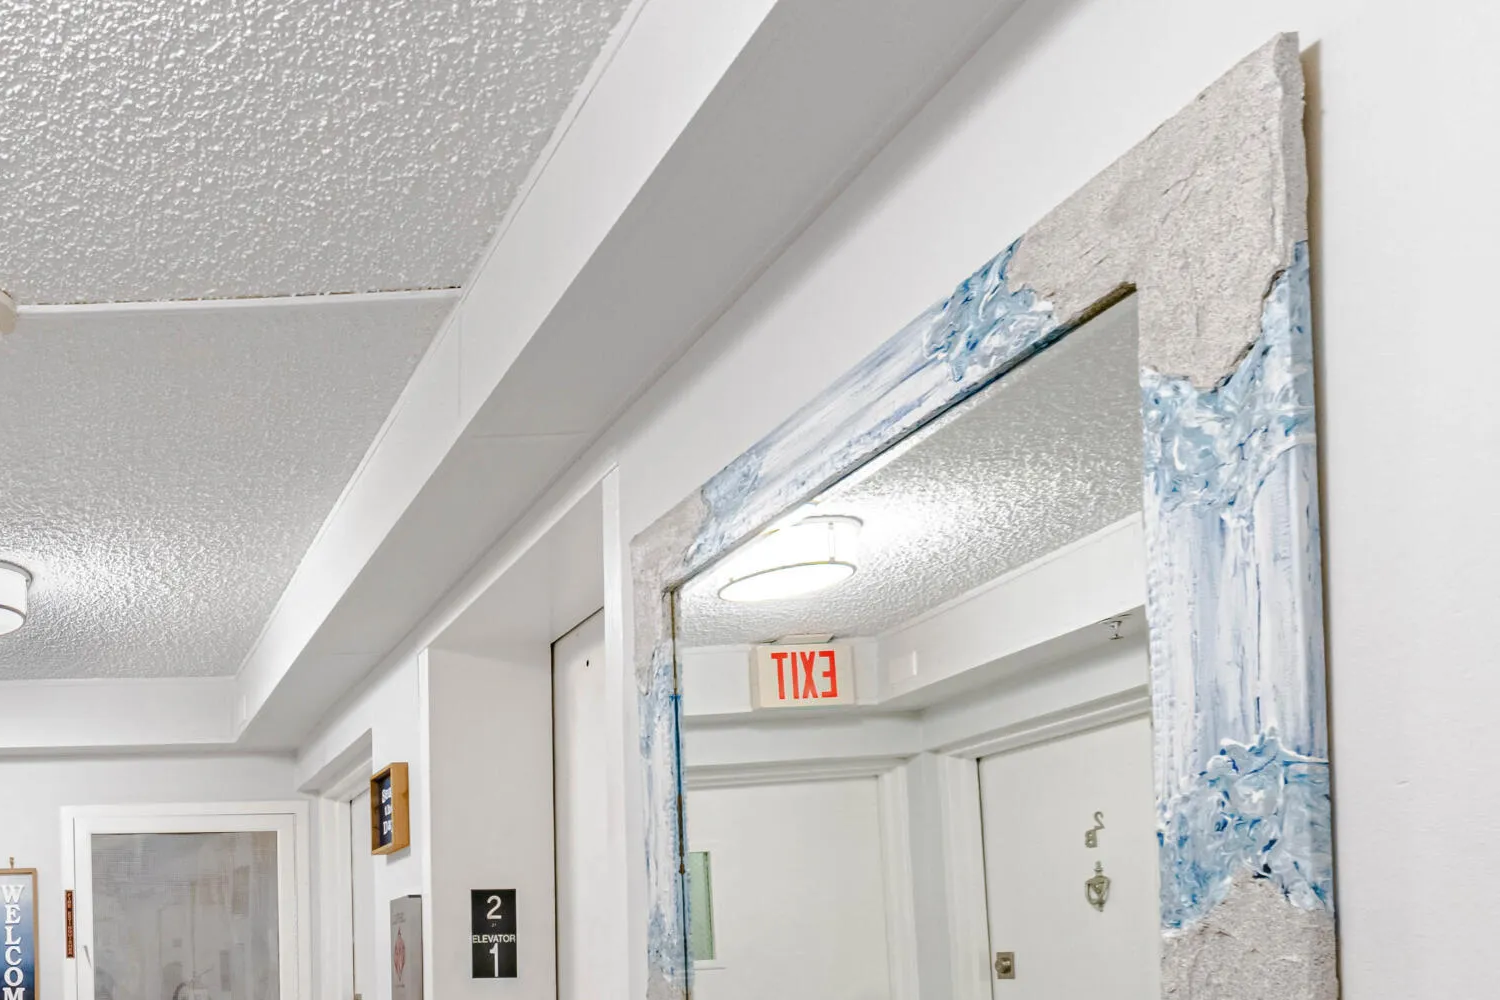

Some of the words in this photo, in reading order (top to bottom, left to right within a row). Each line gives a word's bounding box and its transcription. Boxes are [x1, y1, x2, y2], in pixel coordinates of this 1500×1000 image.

[486, 895, 502, 920] 2
[472, 934, 516, 944] ELEVATOR
[489, 942, 499, 978] 1
